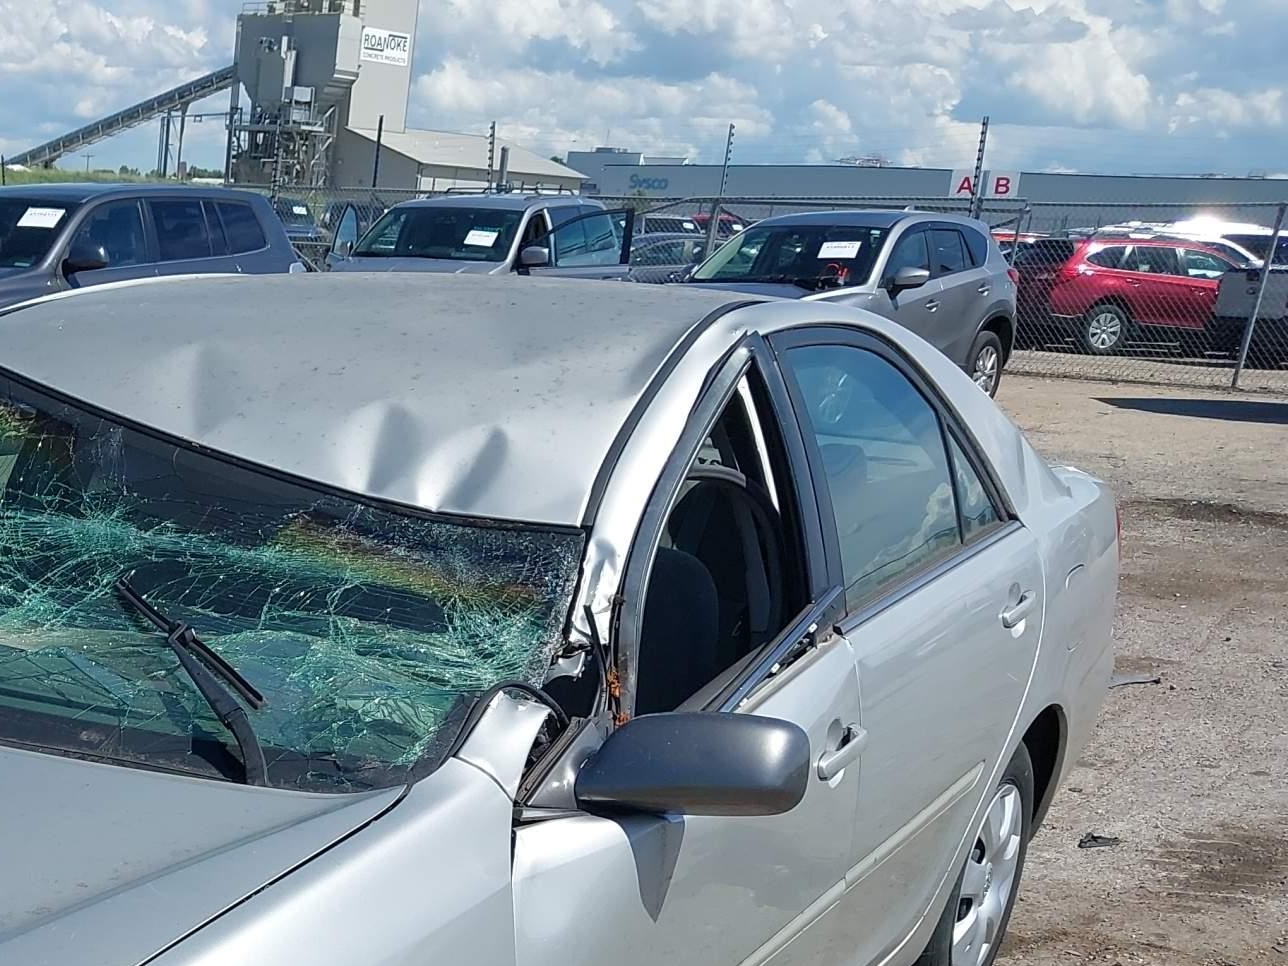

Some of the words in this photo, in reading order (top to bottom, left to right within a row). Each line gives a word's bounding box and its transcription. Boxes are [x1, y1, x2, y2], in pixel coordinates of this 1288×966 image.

[364, 34, 408, 52] ROANOKE
[956, 176, 973, 193] A
[994, 177, 1010, 194] B
